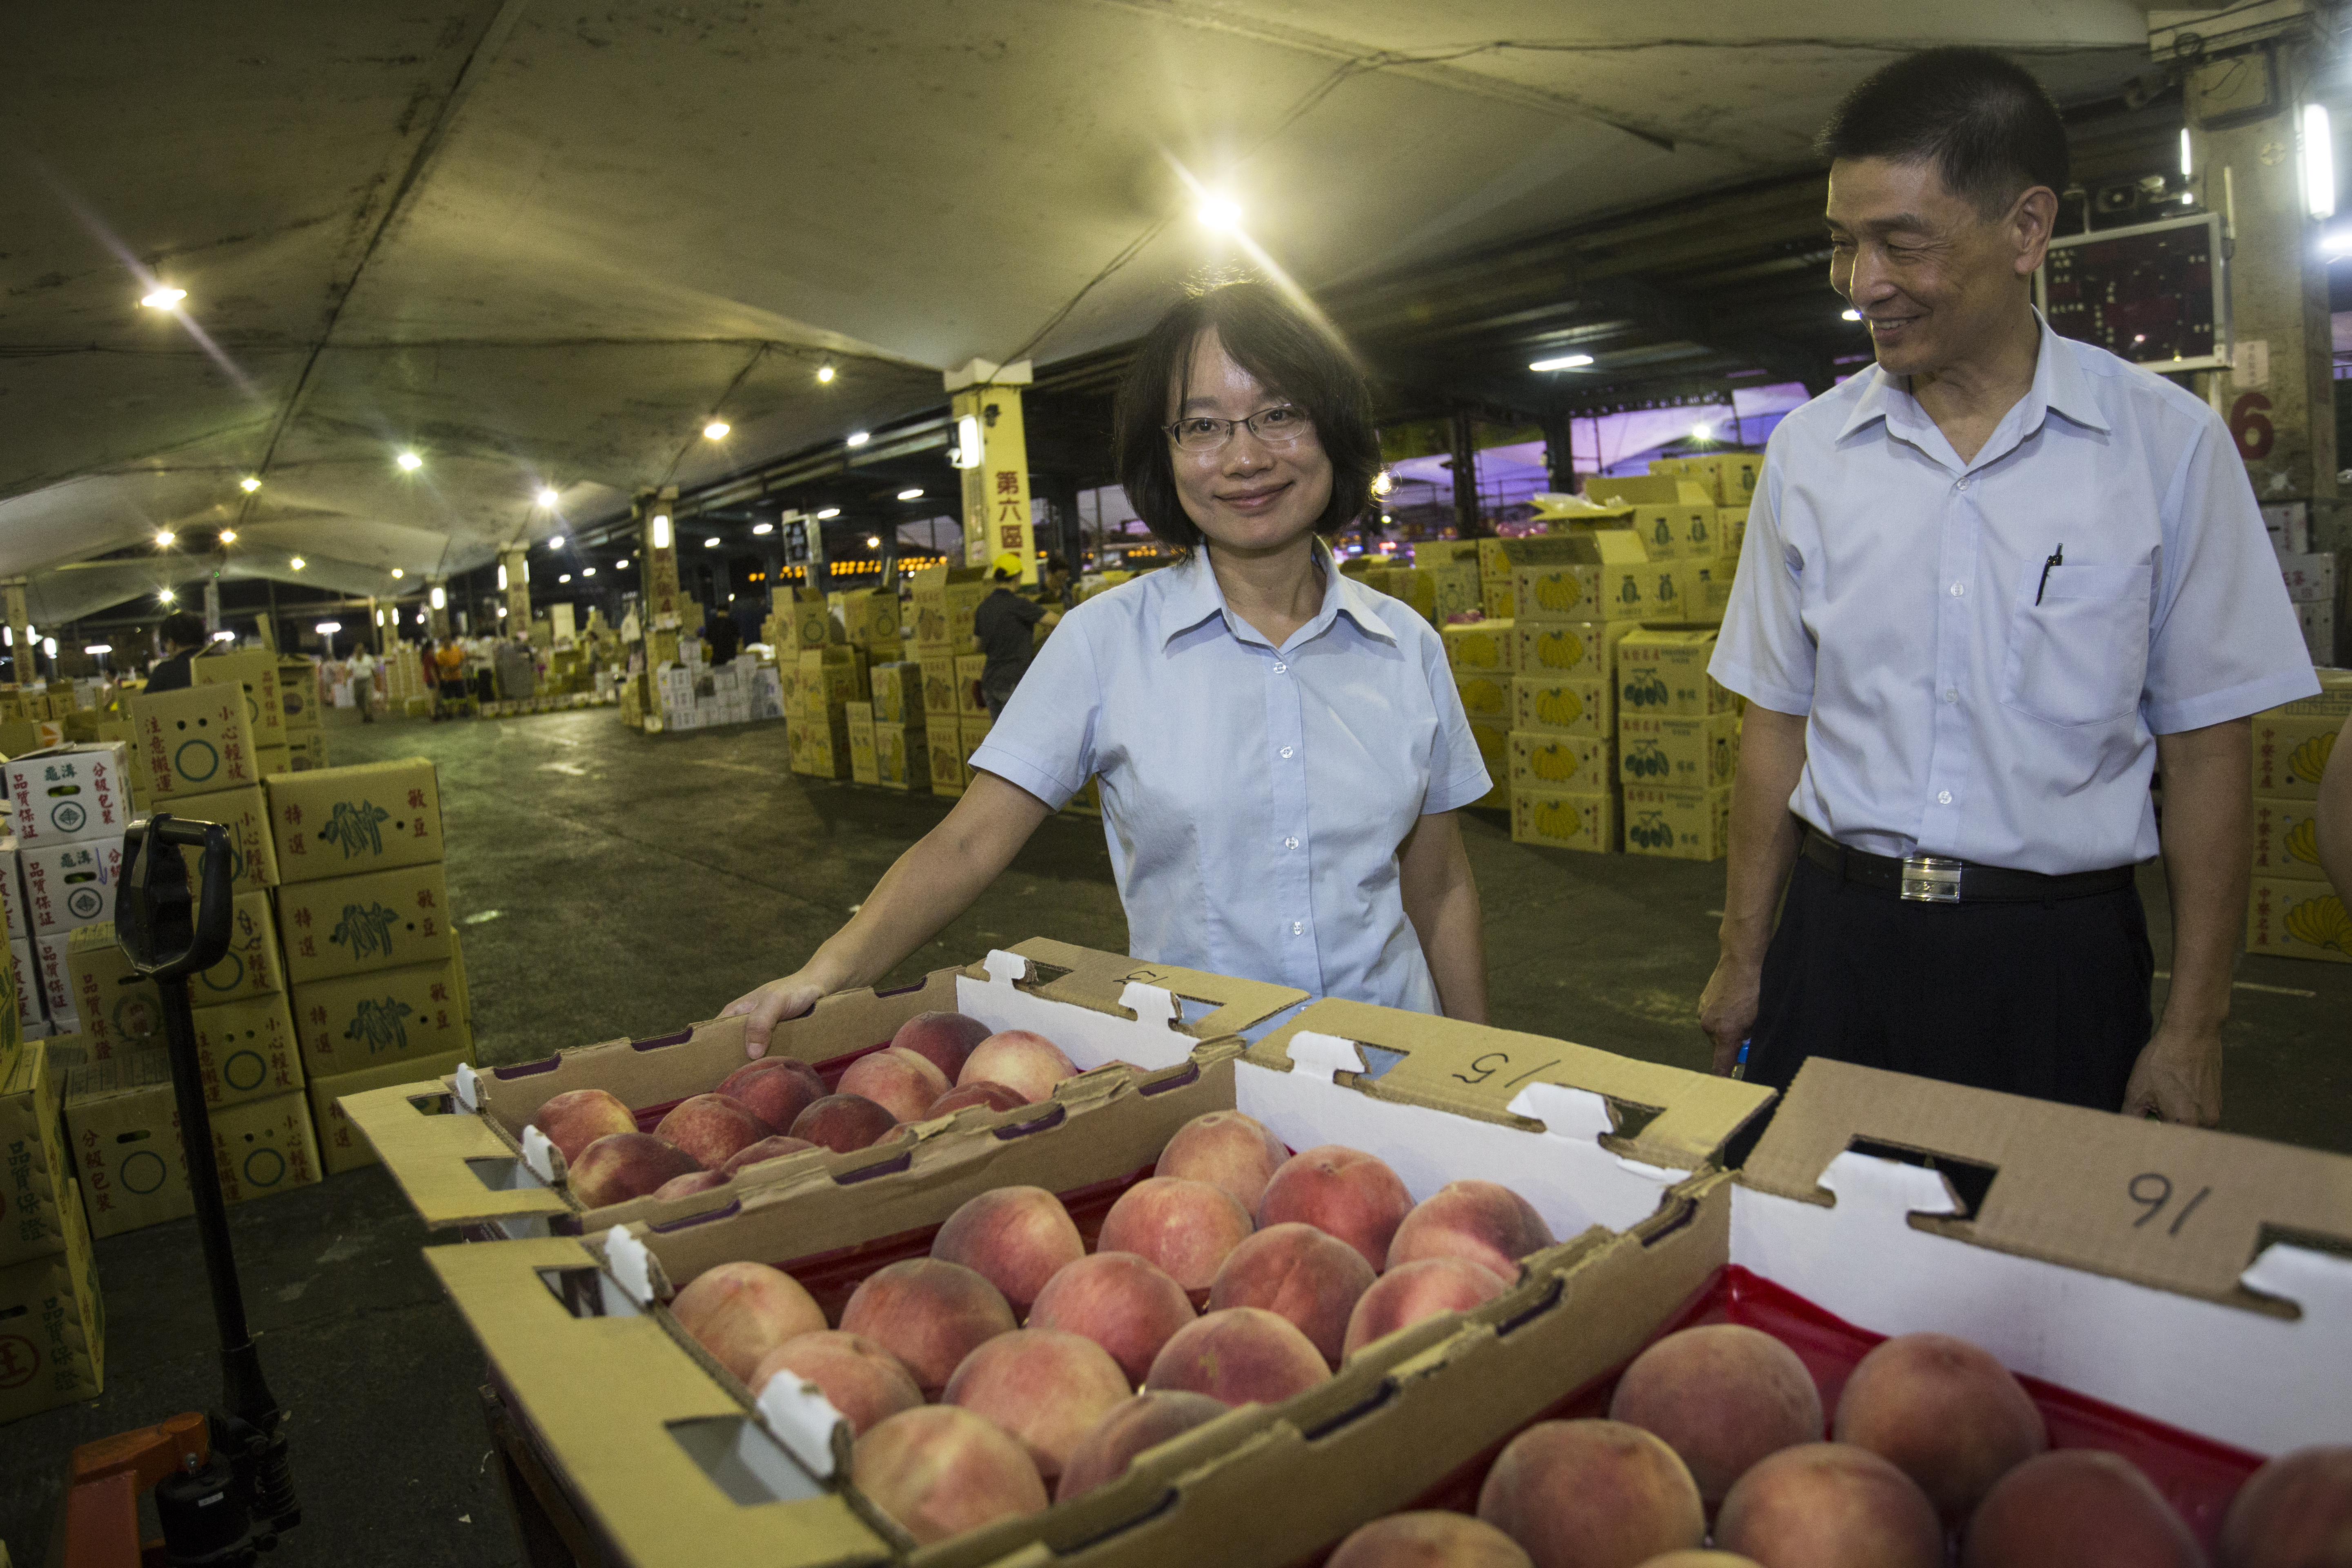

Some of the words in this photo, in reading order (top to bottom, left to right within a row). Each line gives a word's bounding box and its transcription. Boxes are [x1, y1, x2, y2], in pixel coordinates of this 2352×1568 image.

[996, 471, 1022, 548] 第六區
[146, 716, 174, 792] 注意搬運
[219, 706, 246, 778] 小心輕放
[13, 773, 38, 839] 品質保証
[93, 762, 115, 824] 分級包裝
[408, 788, 427, 837] 敏豆
[285, 803, 306, 855] 特選
[30, 862, 55, 926] 品質保証
[417, 889, 437, 937] 敏豆
[295, 907, 317, 957] 特選
[310, 1005, 332, 1053] 特選
[430, 982, 450, 1030] 敏豆
[8, 1140, 47, 1241] 品質保證
[82, 1129, 116, 1212] 分級包裝
[42, 1296, 80, 1391] 品質保證
